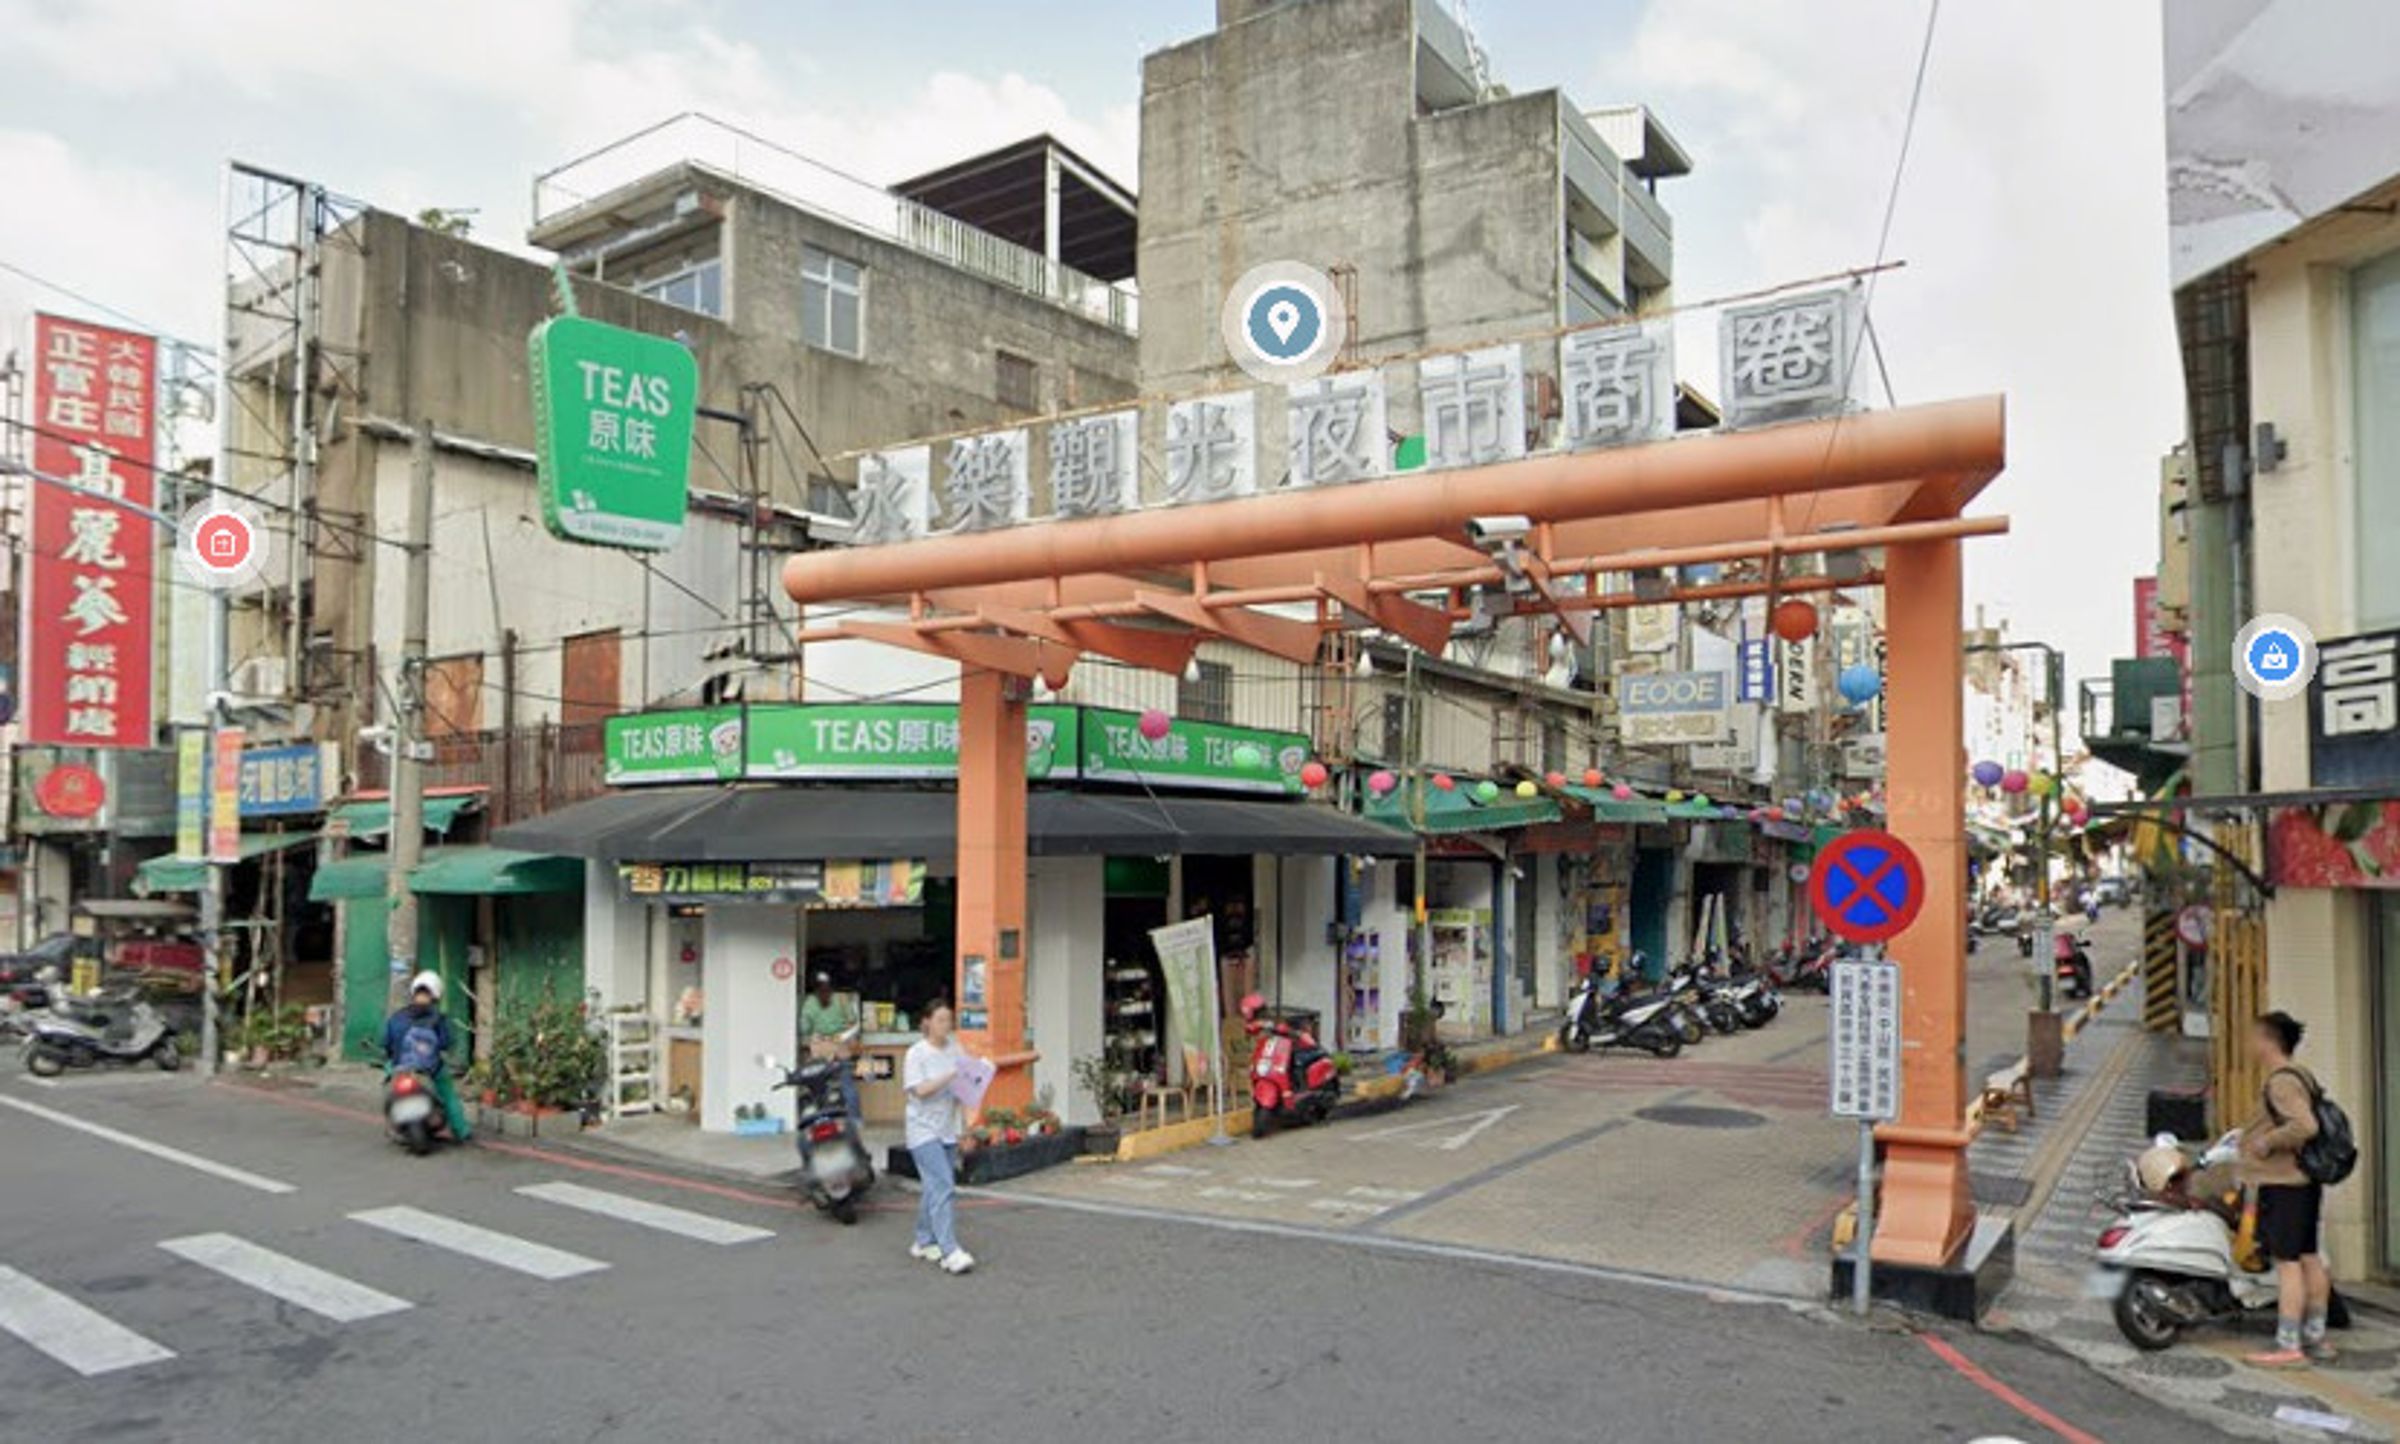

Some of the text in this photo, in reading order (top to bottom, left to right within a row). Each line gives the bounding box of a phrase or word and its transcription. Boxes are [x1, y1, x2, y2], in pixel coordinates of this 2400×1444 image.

[589, 410, 657, 459] 原味
[848, 290, 1849, 543] 永樂觀光夜市商圈
[1788, 642, 1805, 701] DERN
